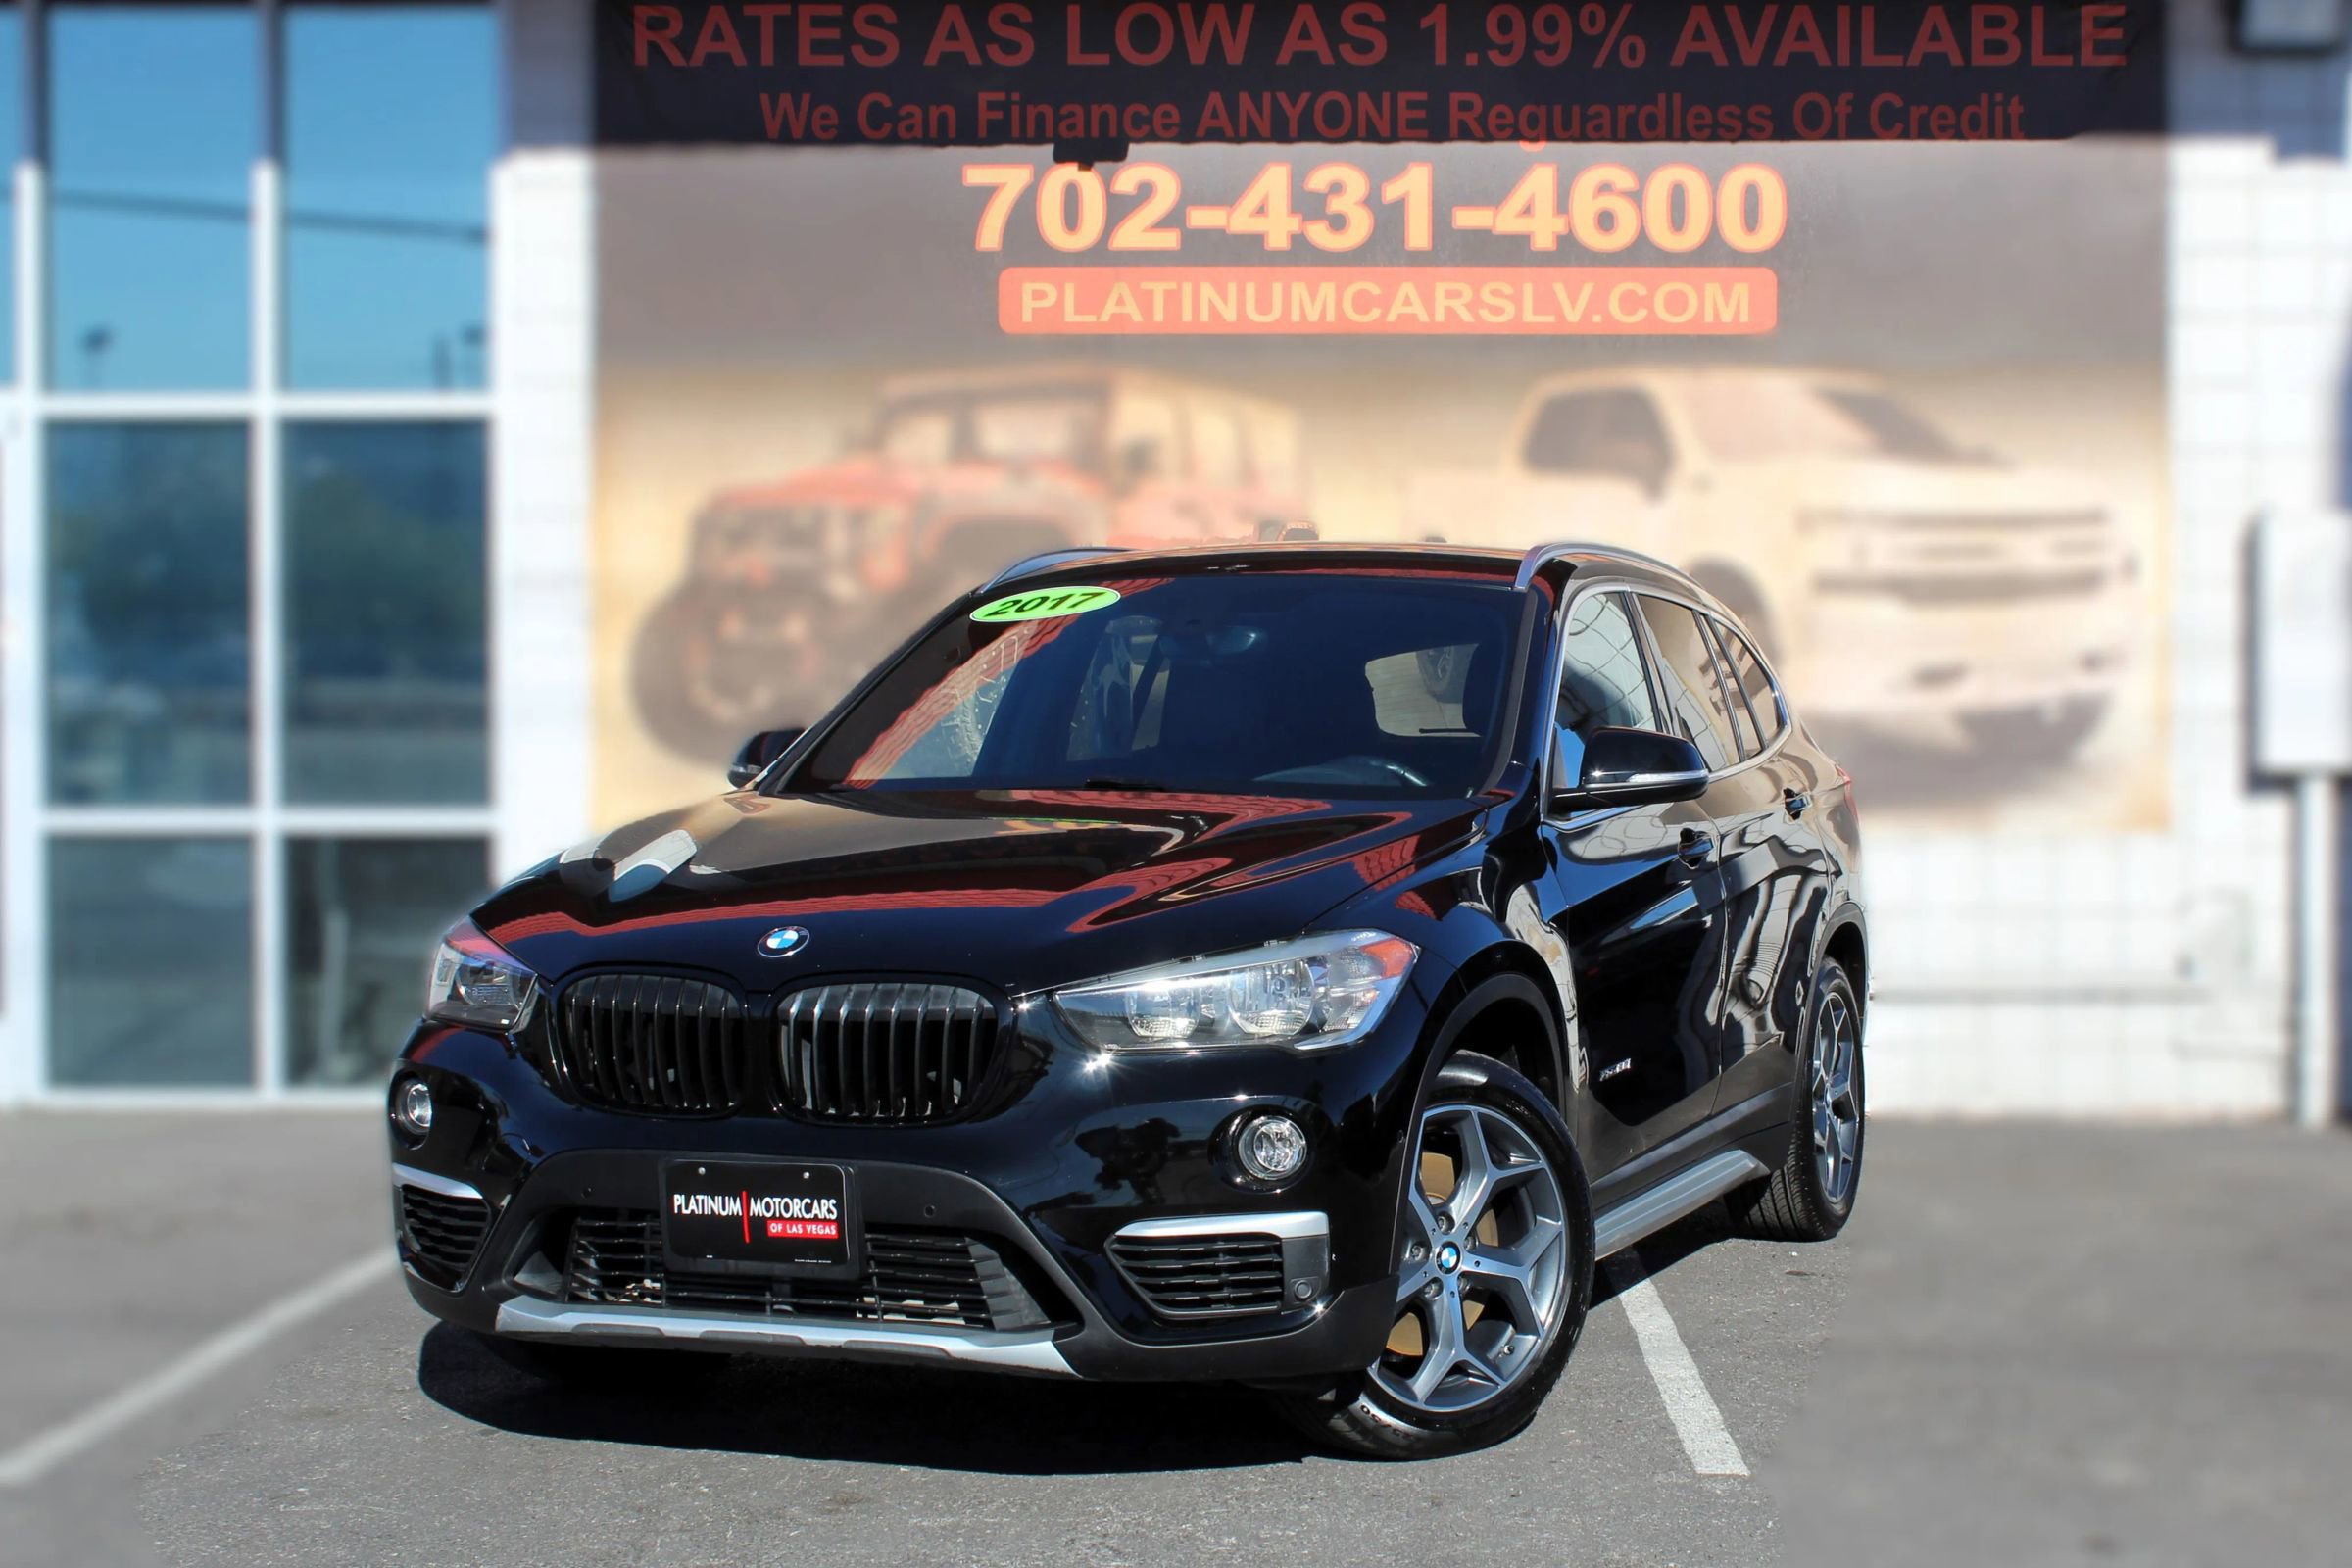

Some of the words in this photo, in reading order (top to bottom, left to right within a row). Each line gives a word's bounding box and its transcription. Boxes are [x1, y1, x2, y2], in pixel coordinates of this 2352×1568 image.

[633, 4, 900, 67] RATES
[923, 3, 1035, 67] AS
[1066, 3, 1254, 66] LOW
[1276, 3, 1388, 66] AS
[1419, 3, 1646, 68] 1.99%
[1670, 4, 2127, 67] AVAILABLE
[760, 93, 839, 139] We
[858, 92, 956, 139] Can
[977, 92, 1181, 139] Finance
[1197, 92, 1429, 138] ANYONE
[1449, 92, 1774, 151] Reguardless
[1792, 92, 1854, 139] Of
[1869, 92, 2026, 139] Credit
[961, 162, 1788, 253] 702-431-4600
[1020, 280, 1751, 324] PLATINUMCARSLV.COM
[983, 591, 1106, 618] 2017
[673, 1194, 743, 1217] PLATINUM
[749, 1197, 838, 1220] MOTORCARS
[769, 1223, 783, 1234] OF
[786, 1223, 803, 1235] LAS
[806, 1224, 837, 1236] VEGAS
